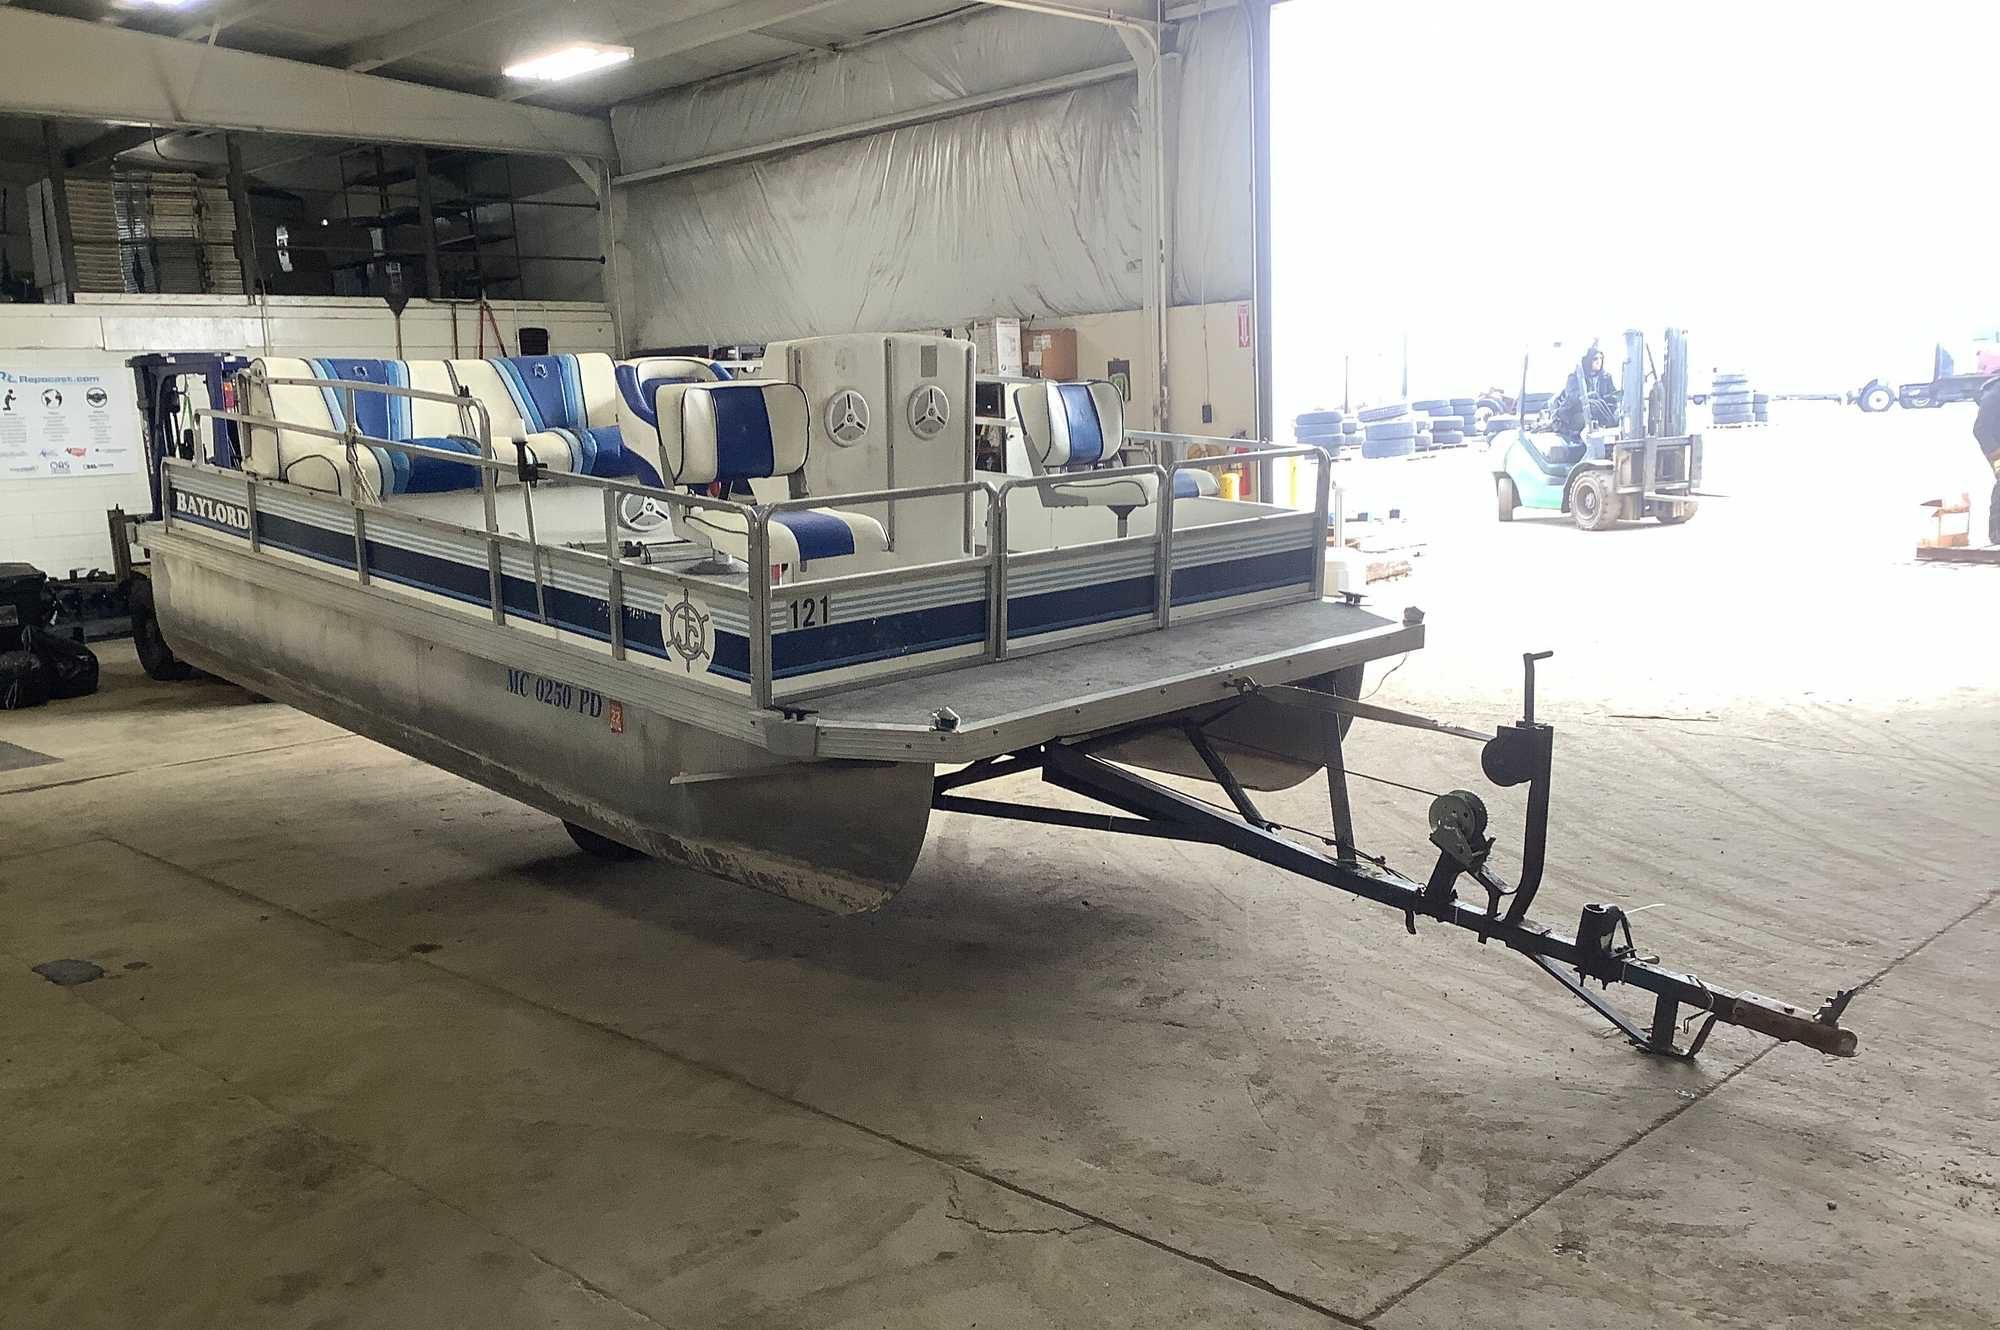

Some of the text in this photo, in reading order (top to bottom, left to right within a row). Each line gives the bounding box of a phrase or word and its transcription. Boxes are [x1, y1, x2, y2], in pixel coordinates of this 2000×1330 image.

[19, 375, 99, 384] Repocast.com
[176, 492, 249, 530] BAYLORD
[790, 595, 828, 628] 121
[507, 669, 602, 718] MC 0250 PD
